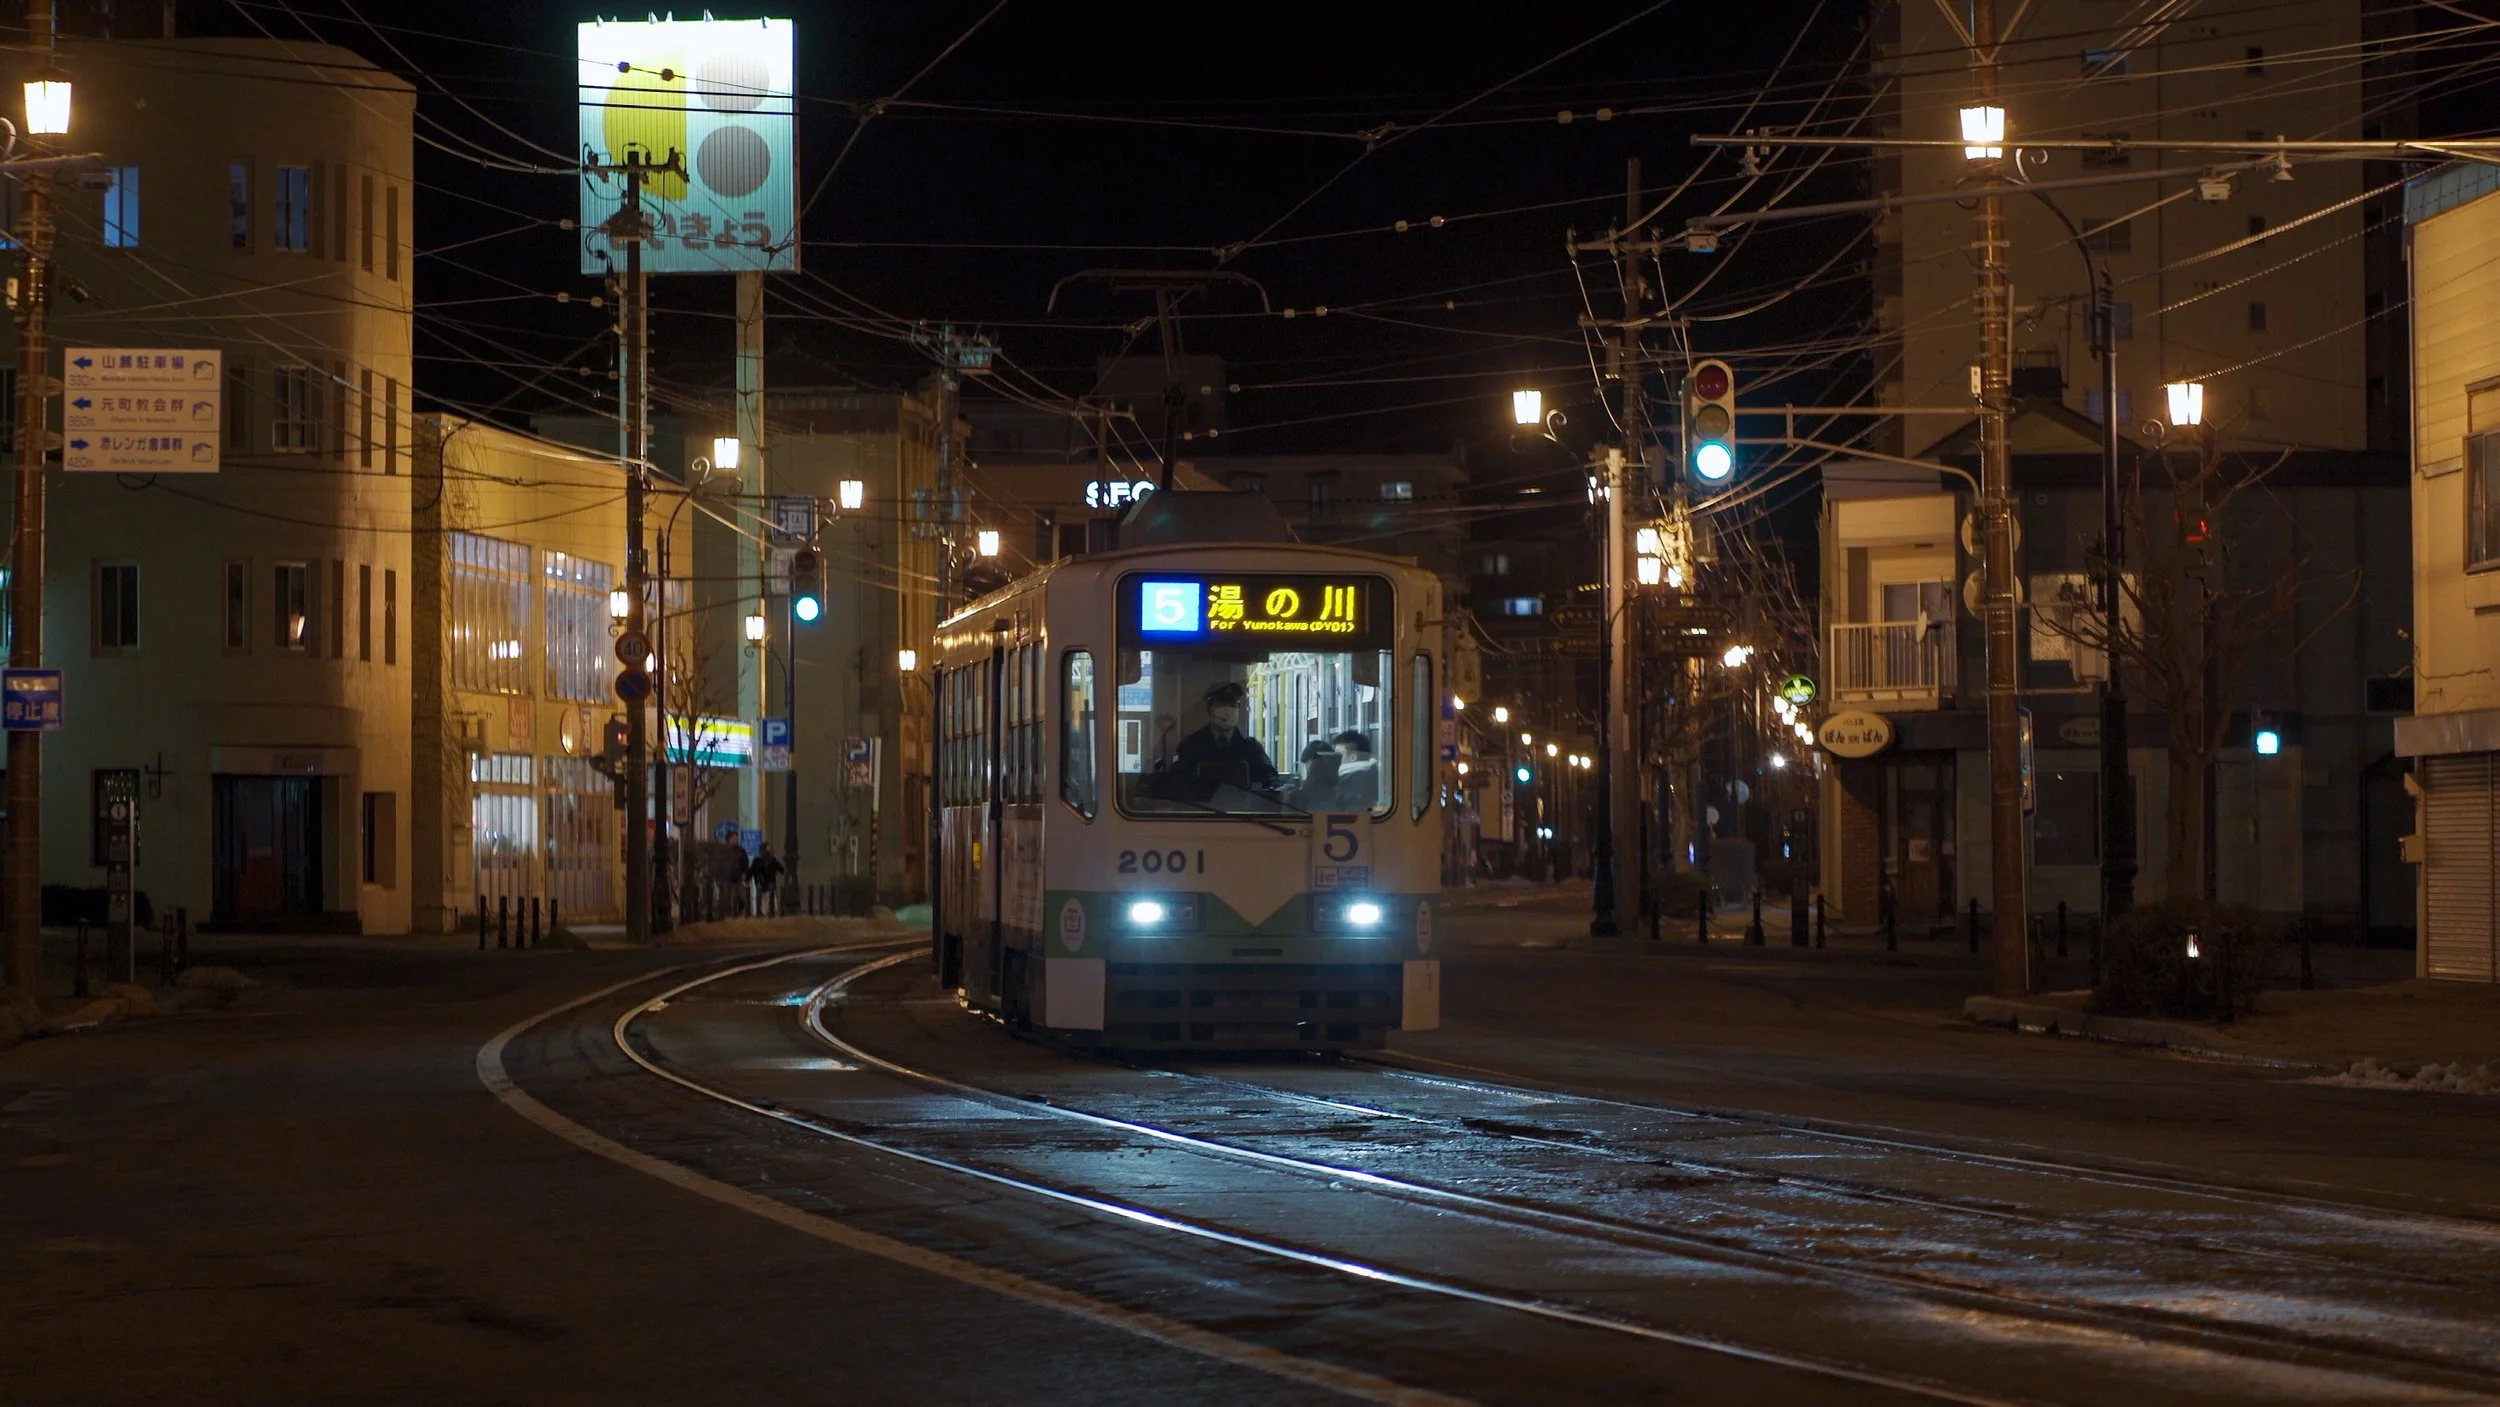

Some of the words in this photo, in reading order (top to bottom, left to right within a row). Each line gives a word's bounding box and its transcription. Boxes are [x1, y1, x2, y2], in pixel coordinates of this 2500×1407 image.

[609, 211, 772, 250] いきょう
[1154, 587, 1186, 624] 5
[1207, 585, 1355, 621] 湯の川
[1210, 620, 1236, 630] For
[624, 641, 643, 657] 40
[766, 722, 786, 743] P
[1323, 815, 1359, 862] 5
[1118, 850, 1205, 874] 2001
